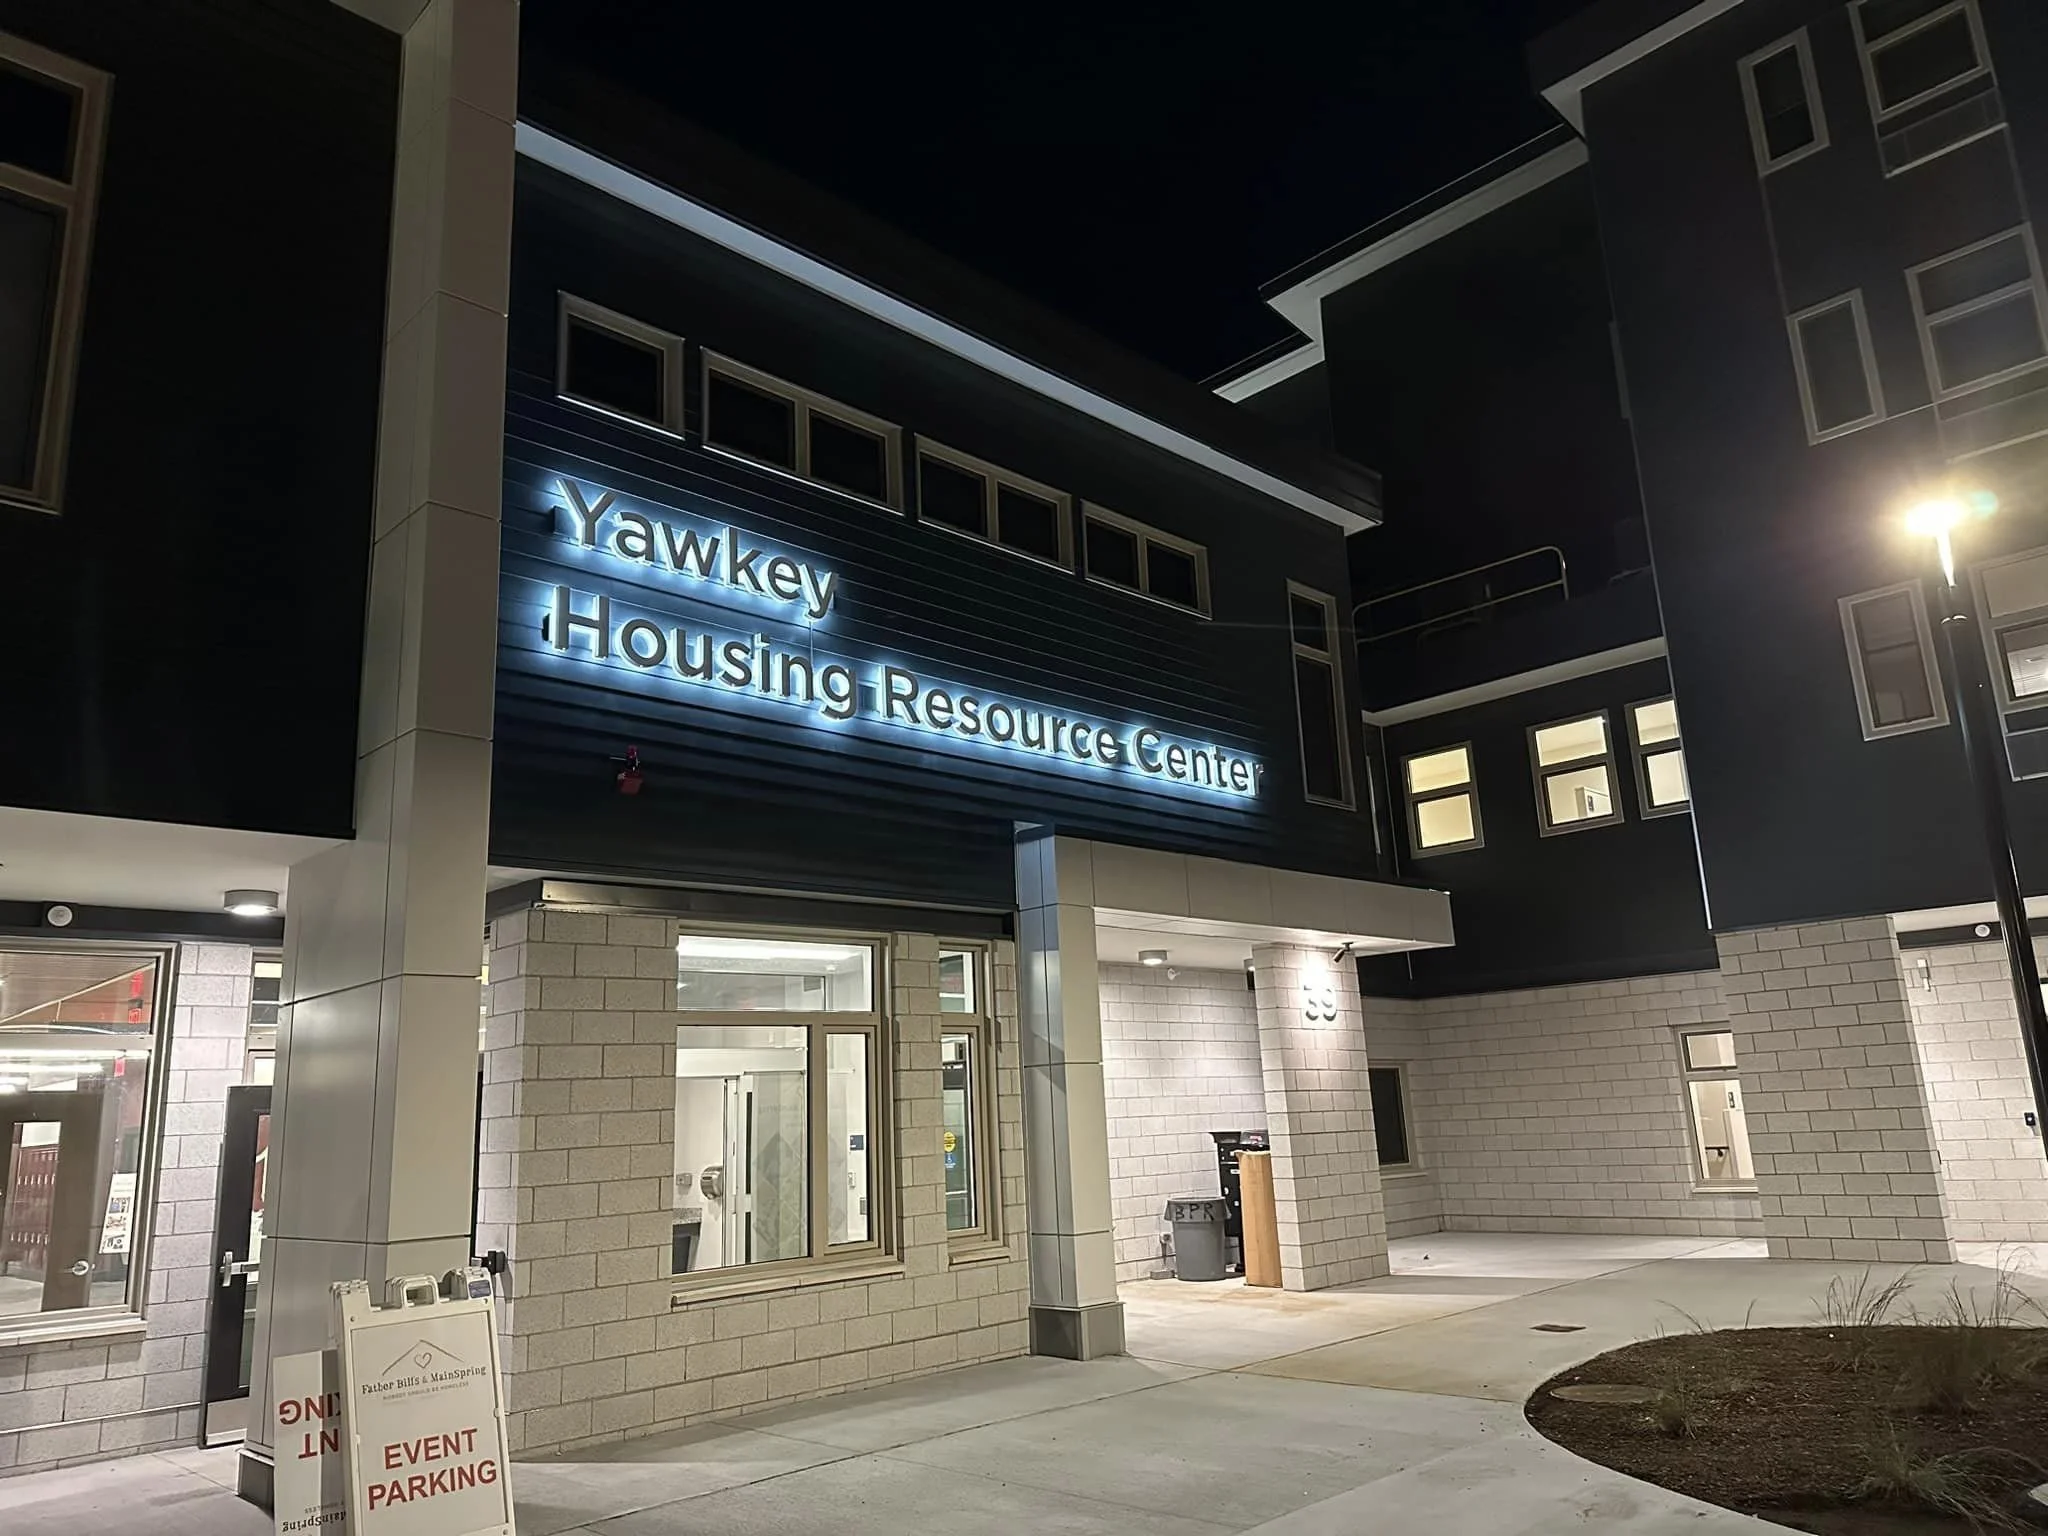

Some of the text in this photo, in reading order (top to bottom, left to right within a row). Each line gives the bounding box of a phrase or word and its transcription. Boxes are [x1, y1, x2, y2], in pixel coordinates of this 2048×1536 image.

[556, 479, 838, 620] Yawkey
[553, 585, 1264, 796] Housing Resource Center
[1175, 1202, 1215, 1221] BPR
[361, 1381, 394, 1395] Father
[431, 1366, 487, 1383] MainSpring
[384, 1428, 478, 1470] EVENT
[368, 1459, 497, 1510] PARKING
